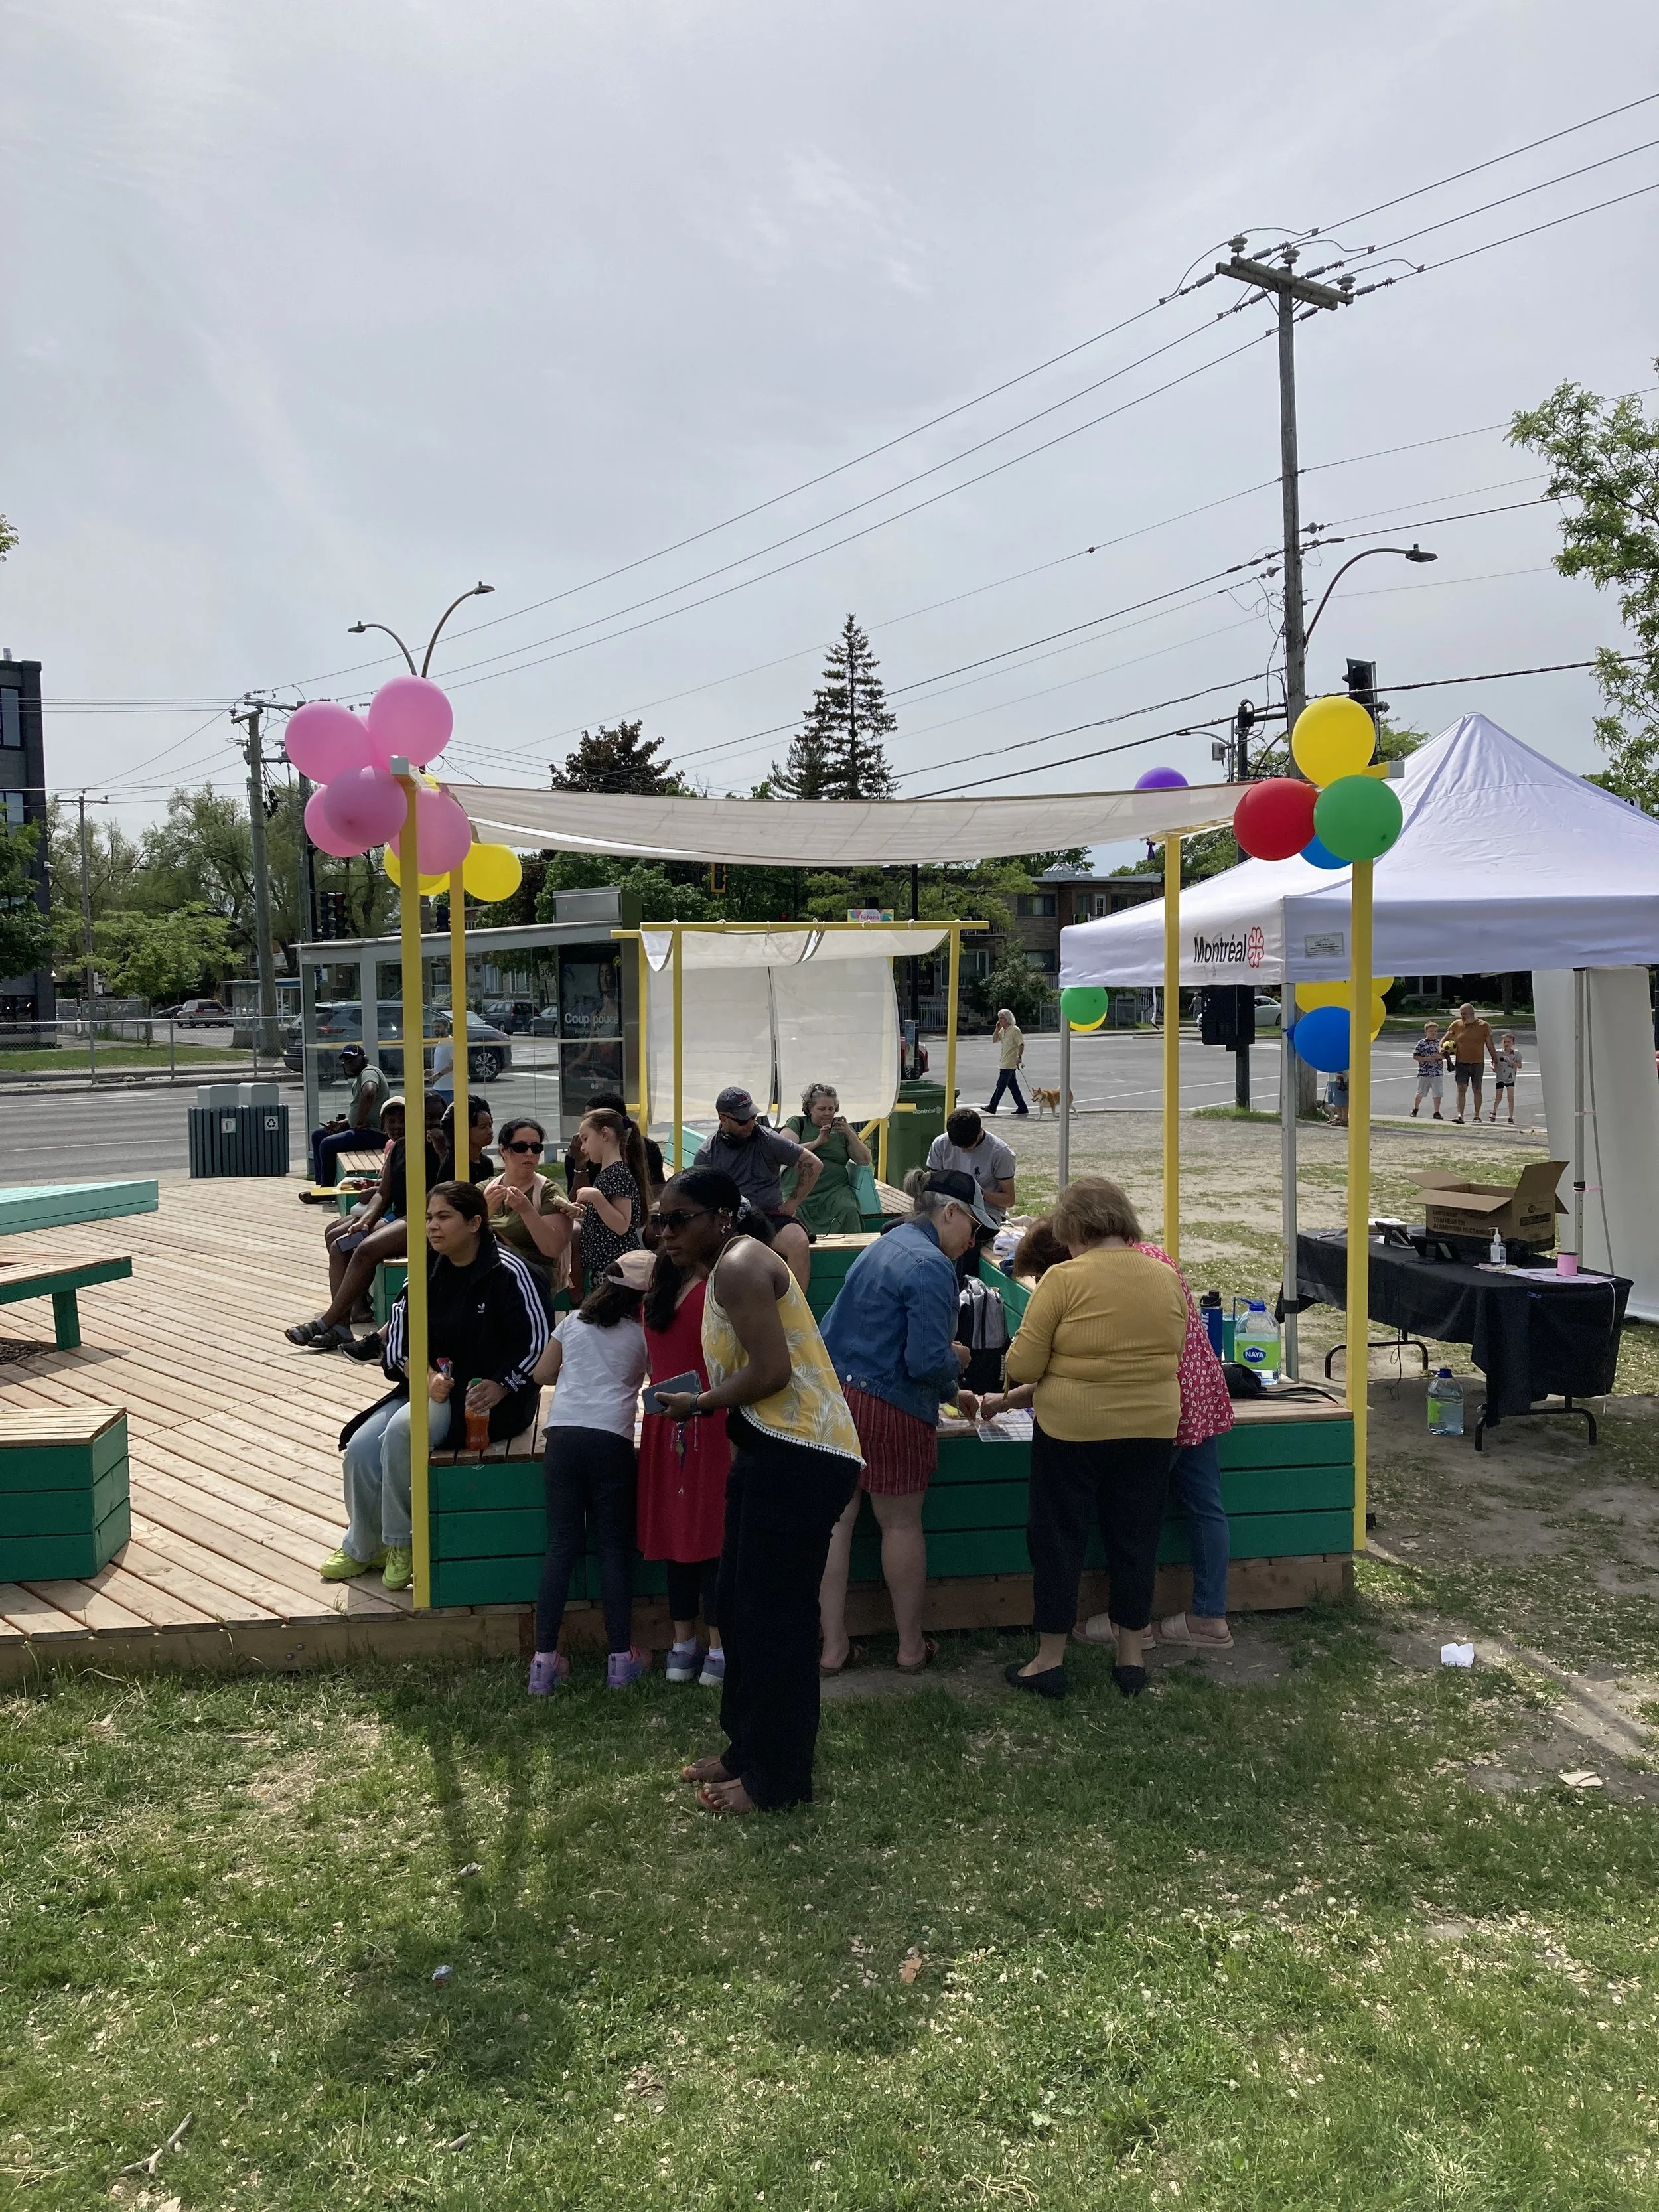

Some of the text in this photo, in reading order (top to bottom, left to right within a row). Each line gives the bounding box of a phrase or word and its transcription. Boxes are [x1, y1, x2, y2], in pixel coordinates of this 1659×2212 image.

[1194, 934, 1246, 963] Montréal
[565, 1013, 618, 1027] Coup pouce
[504, 1376, 518, 1392] adidas
